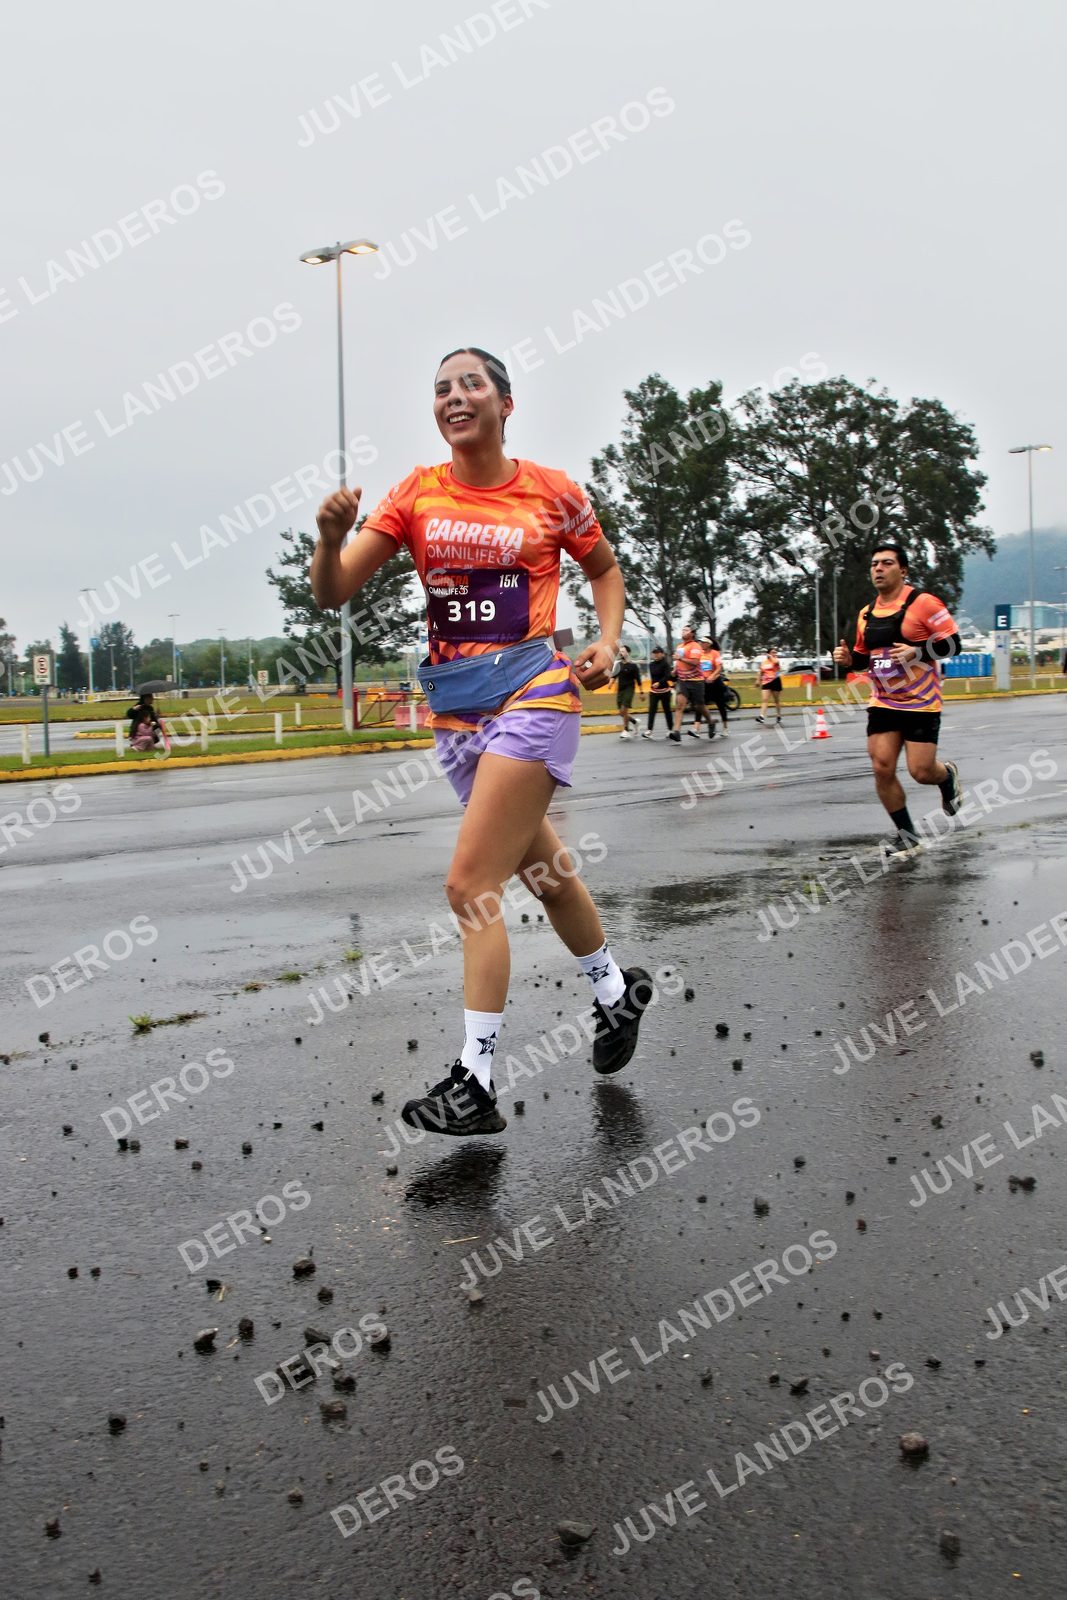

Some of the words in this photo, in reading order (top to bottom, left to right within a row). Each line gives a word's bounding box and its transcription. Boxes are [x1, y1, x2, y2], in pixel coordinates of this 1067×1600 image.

[425, 518, 524, 549] CARRERA
[427, 545, 497, 564] OMNILIFE
[499, 574, 520, 588] 15K
[447, 600, 496, 622] 319
[997, 615, 1007, 627] E
[873, 659, 892, 669] 378
